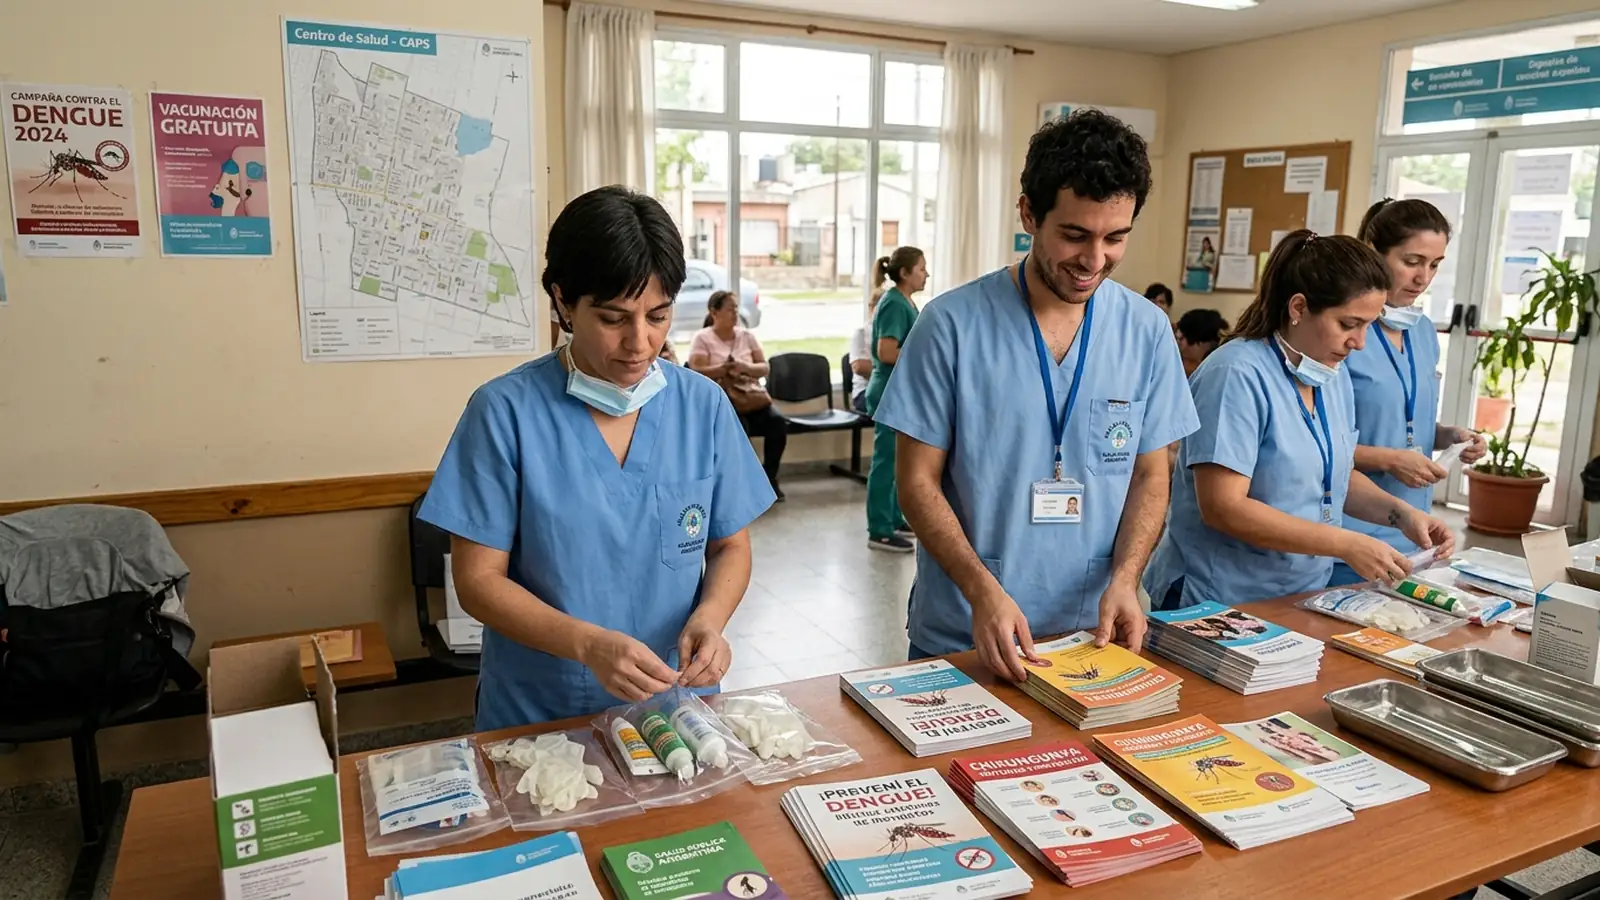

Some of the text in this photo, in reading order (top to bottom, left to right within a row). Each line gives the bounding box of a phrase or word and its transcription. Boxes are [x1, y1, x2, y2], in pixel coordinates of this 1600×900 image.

[295, 27, 336, 42] Centro
[338, 31, 353, 43] de
[356, 33, 389, 46] Salud
[399, 36, 430, 49] CAPS
[109, 97, 122, 106] EL
[12, 104, 123, 127] DENGUE
[159, 103, 257, 120] VACUNACIÓN
[14, 125, 69, 143] 2024
[160, 119, 258, 139] GRATUITA
[907, 778, 928, 789] EL
[825, 786, 936, 813] DENGUE!
